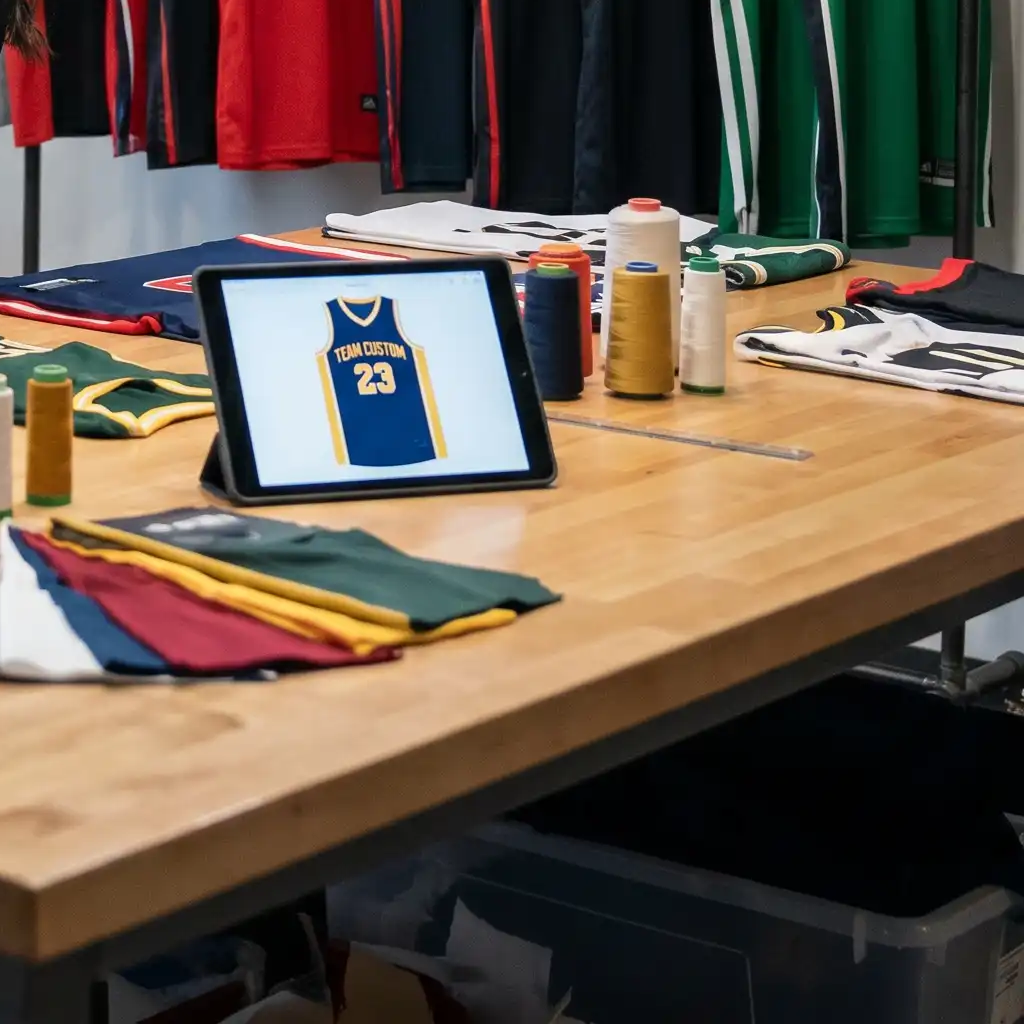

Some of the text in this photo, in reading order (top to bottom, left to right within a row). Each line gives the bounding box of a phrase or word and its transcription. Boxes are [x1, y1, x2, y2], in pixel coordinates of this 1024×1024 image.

[334, 341, 407, 363] TEAM CUSTOM
[353, 362, 397, 395] 23
